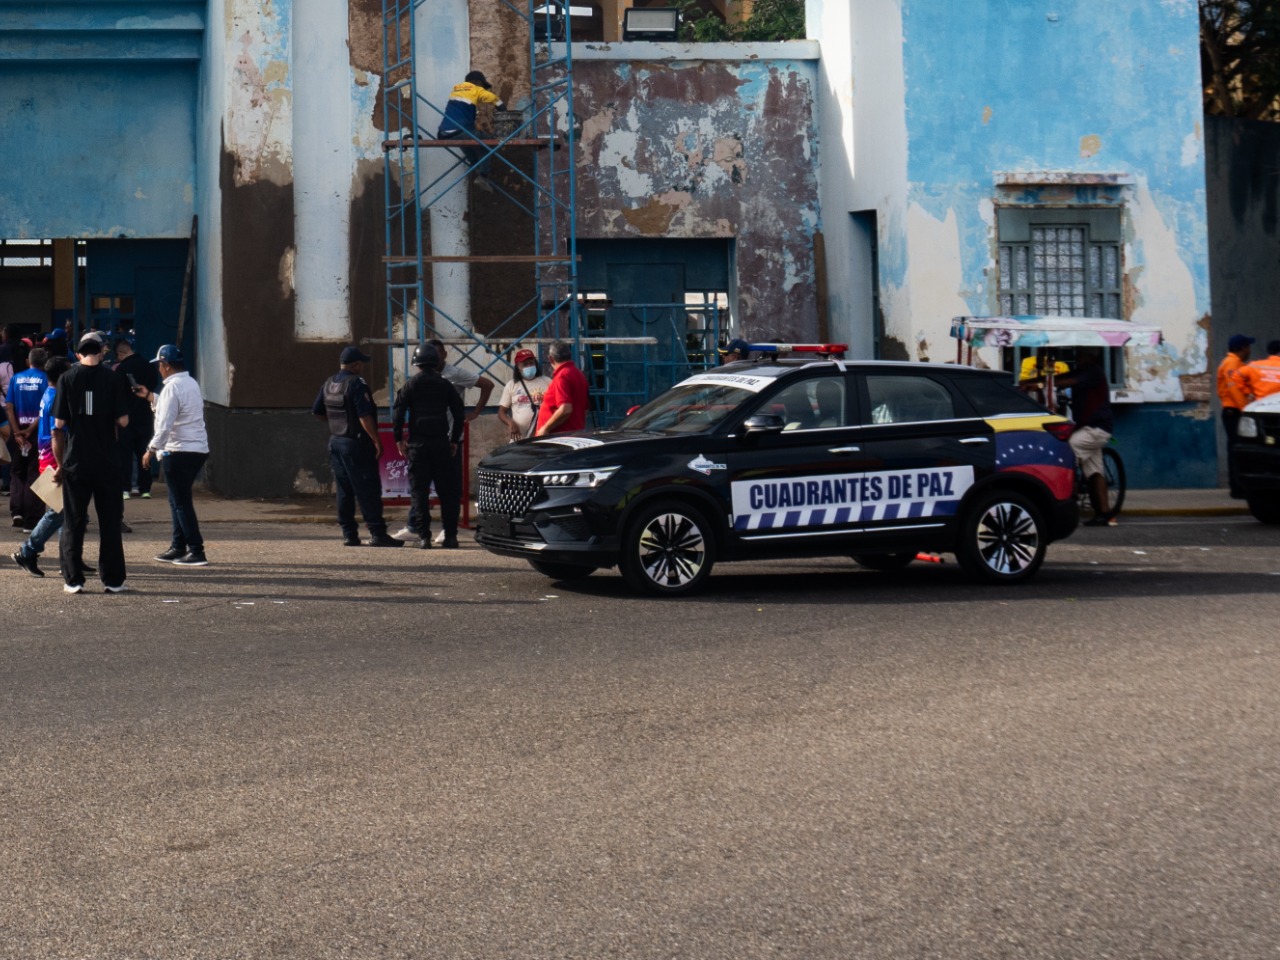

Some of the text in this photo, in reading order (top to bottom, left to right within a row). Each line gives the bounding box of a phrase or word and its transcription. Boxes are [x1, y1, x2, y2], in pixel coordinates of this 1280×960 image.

[388, 469, 401, 480] Se
[749, 471, 954, 510] CUADRANTES DE PAZ
